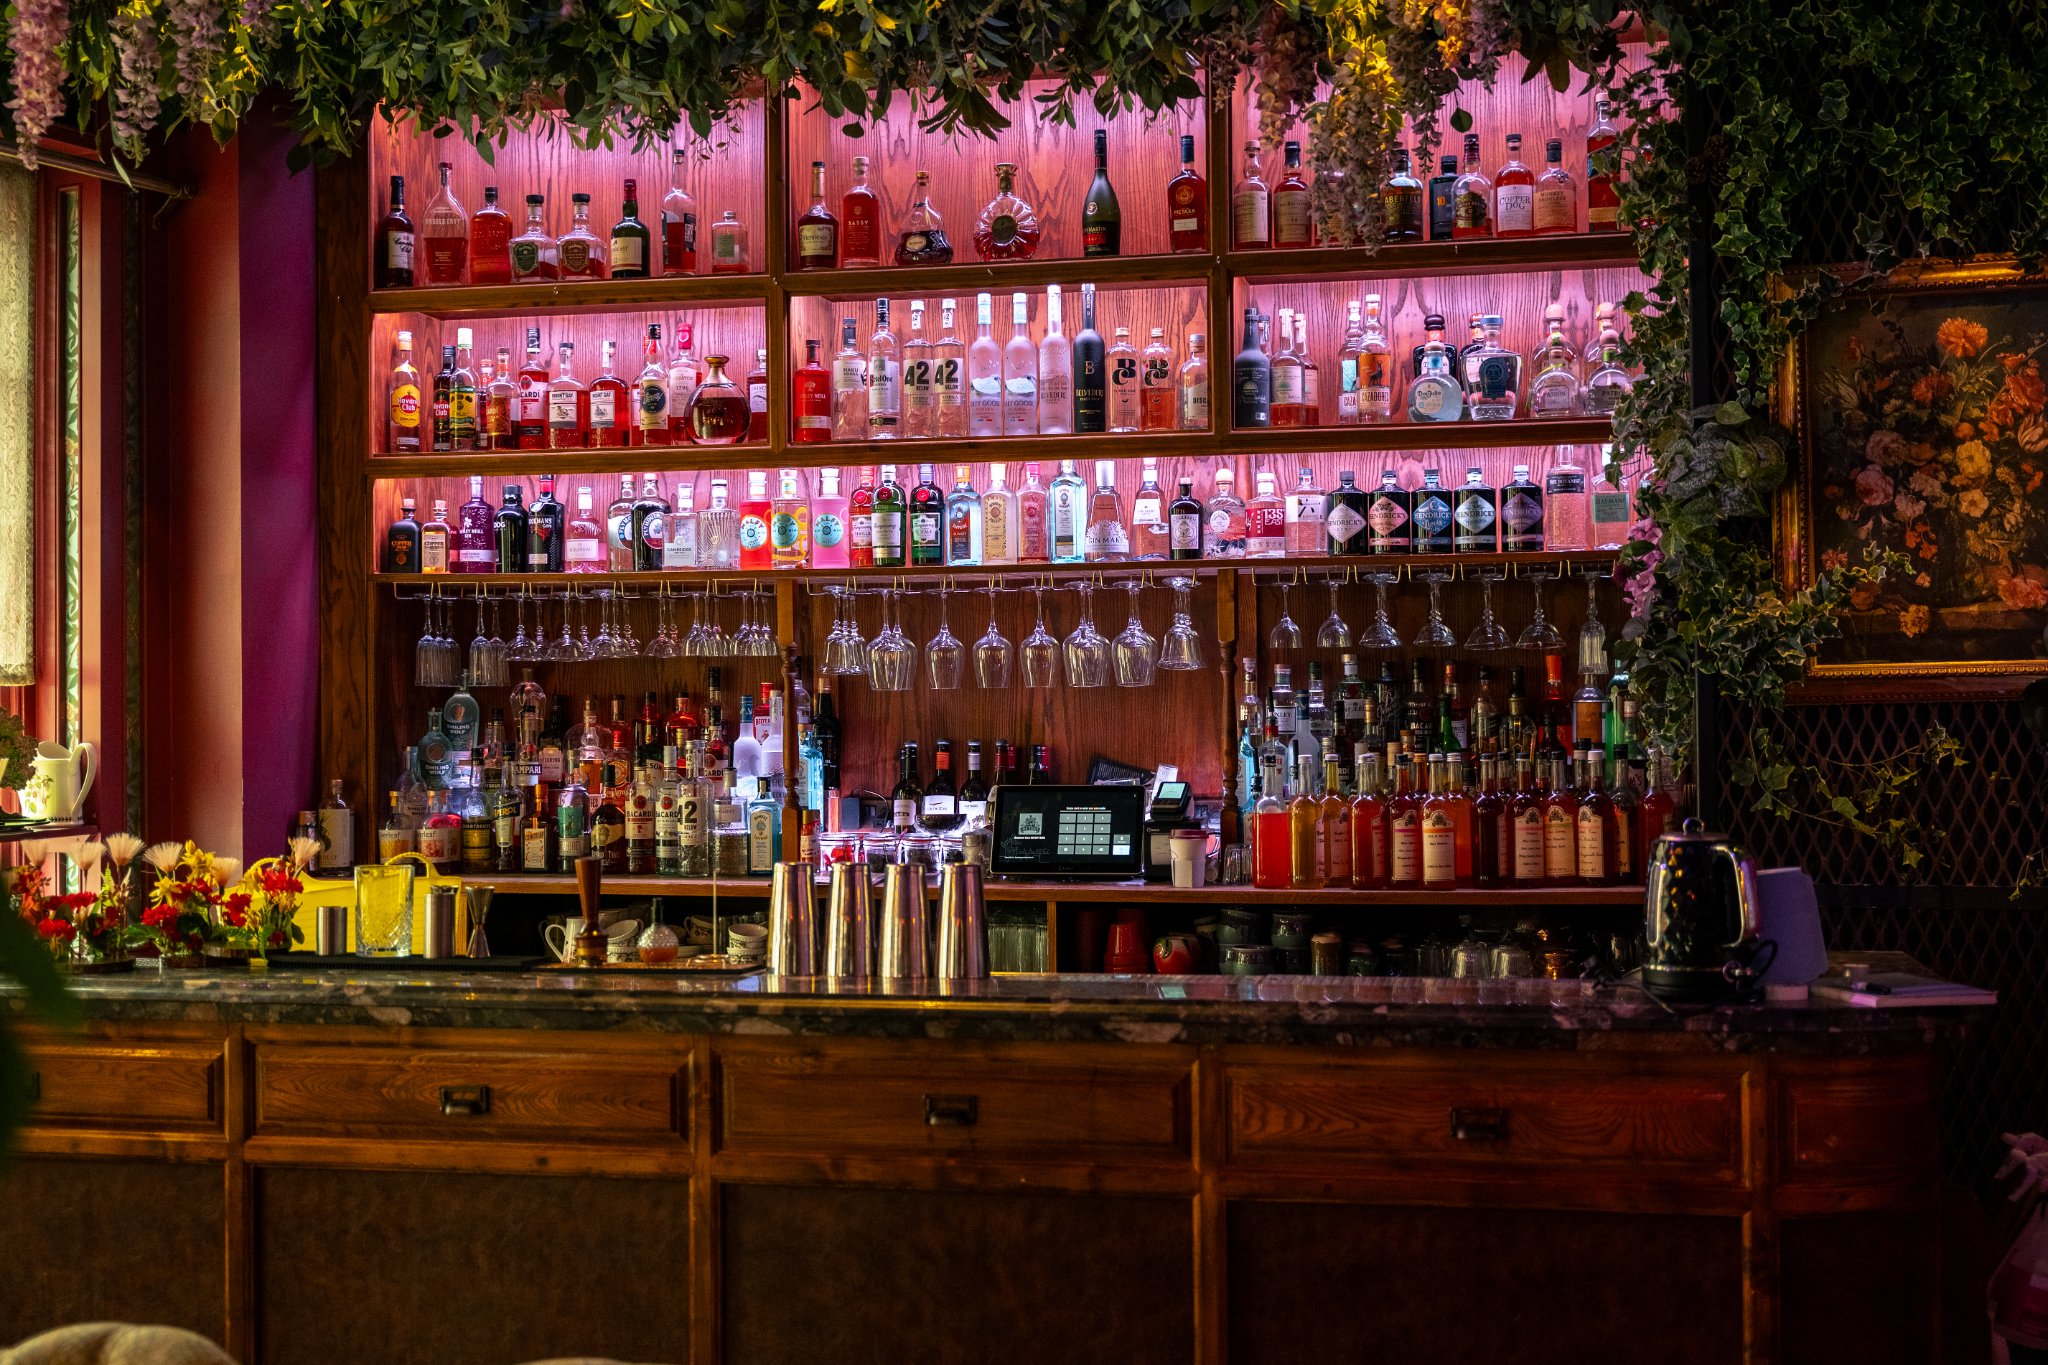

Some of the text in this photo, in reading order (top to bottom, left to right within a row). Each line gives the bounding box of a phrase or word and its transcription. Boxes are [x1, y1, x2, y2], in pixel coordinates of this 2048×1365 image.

[1437, 196, 1446, 205] 10
[1499, 196, 1530, 206] COPPER
[1505, 203, 1525, 211] DOG
[905, 361, 929, 387] 42
[935, 360, 958, 386] 42
[402, 401, 415, 411] Club
[436, 408, 447, 416] Club
[741, 516, 765, 529] MALFY
[815, 516, 841, 526] MALFY
